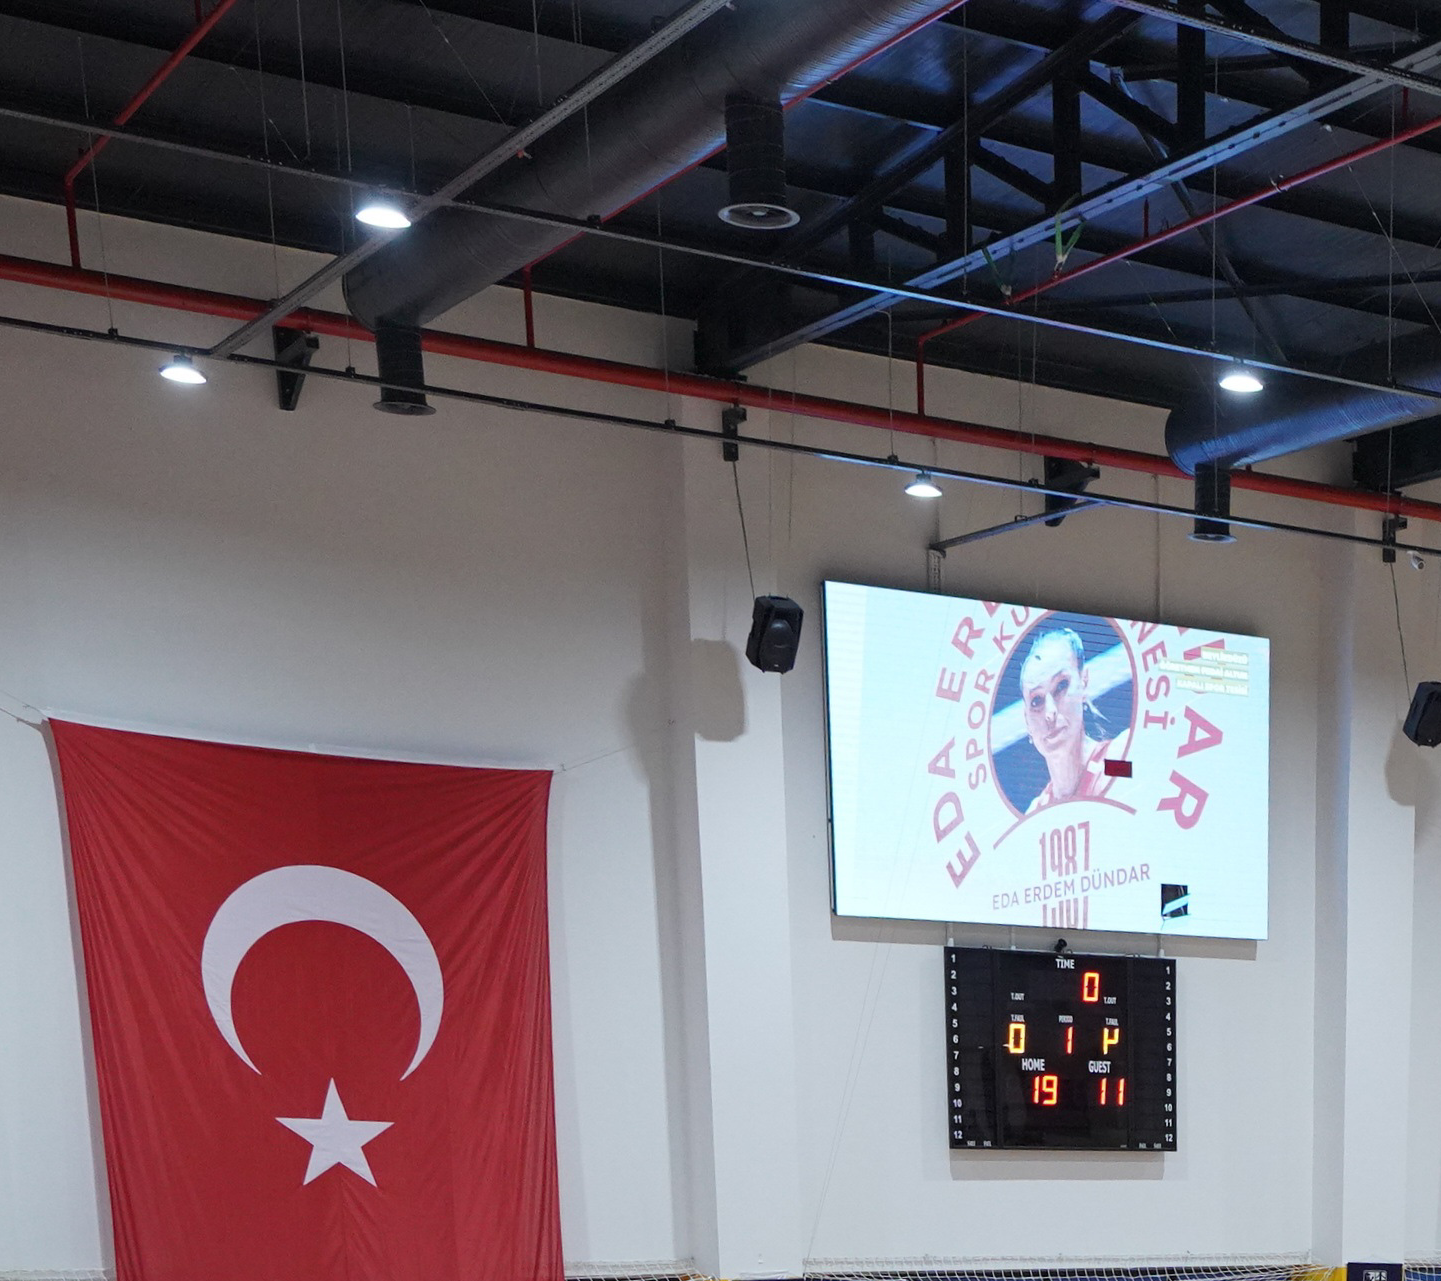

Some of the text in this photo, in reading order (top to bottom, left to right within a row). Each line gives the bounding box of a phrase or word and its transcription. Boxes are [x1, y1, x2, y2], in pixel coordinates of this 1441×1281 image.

[966, 668, 995, 790] SPOR
[993, 863, 1150, 910] EDA ERDEM DÜNDAR
[950, 955, 957, 963] 1
[1056, 959, 1075, 969] TIME
[1166, 966, 1171, 974] 1
[950, 971, 957, 979] 2
[1083, 971, 1100, 1002] 0
[1165, 982, 1171, 990] 2
[951, 987, 958, 995] 3
[1011, 993, 1024, 1001] T.OUT
[1166, 997, 1171, 1005] 3
[951, 1003, 958, 1011] 4
[1166, 1013, 1171, 1021] 4
[952, 1019, 958, 1028] 5
[1166, 1028, 1172, 1036] 5
[952, 1035, 959, 1043] 6
[1009, 1023, 1026, 1054] 0
[1067, 1026, 1073, 1054] 1
[1166, 1043, 1172, 1051] 6
[953, 1052, 959, 1060] 7
[1022, 1058, 1045, 1071] HOME
[1167, 1058, 1172, 1066] 7
[1088, 1061, 1111, 1073] GUEST
[953, 1067, 960, 1076] 8
[1166, 1073, 1172, 1082] 8
[954, 1083, 961, 1092] 9
[1033, 1075, 1058, 1105] 19
[1100, 1078, 1125, 1105] 11
[1166, 1088, 1172, 1097] 9
[952, 1099, 963, 1108] 10
[1164, 1103, 1173, 1112] 10
[953, 1115, 963, 1123] 11
[1164, 1119, 1173, 1127] 11
[953, 1131, 963, 1139] 12
[1164, 1134, 1173, 1142] 12
